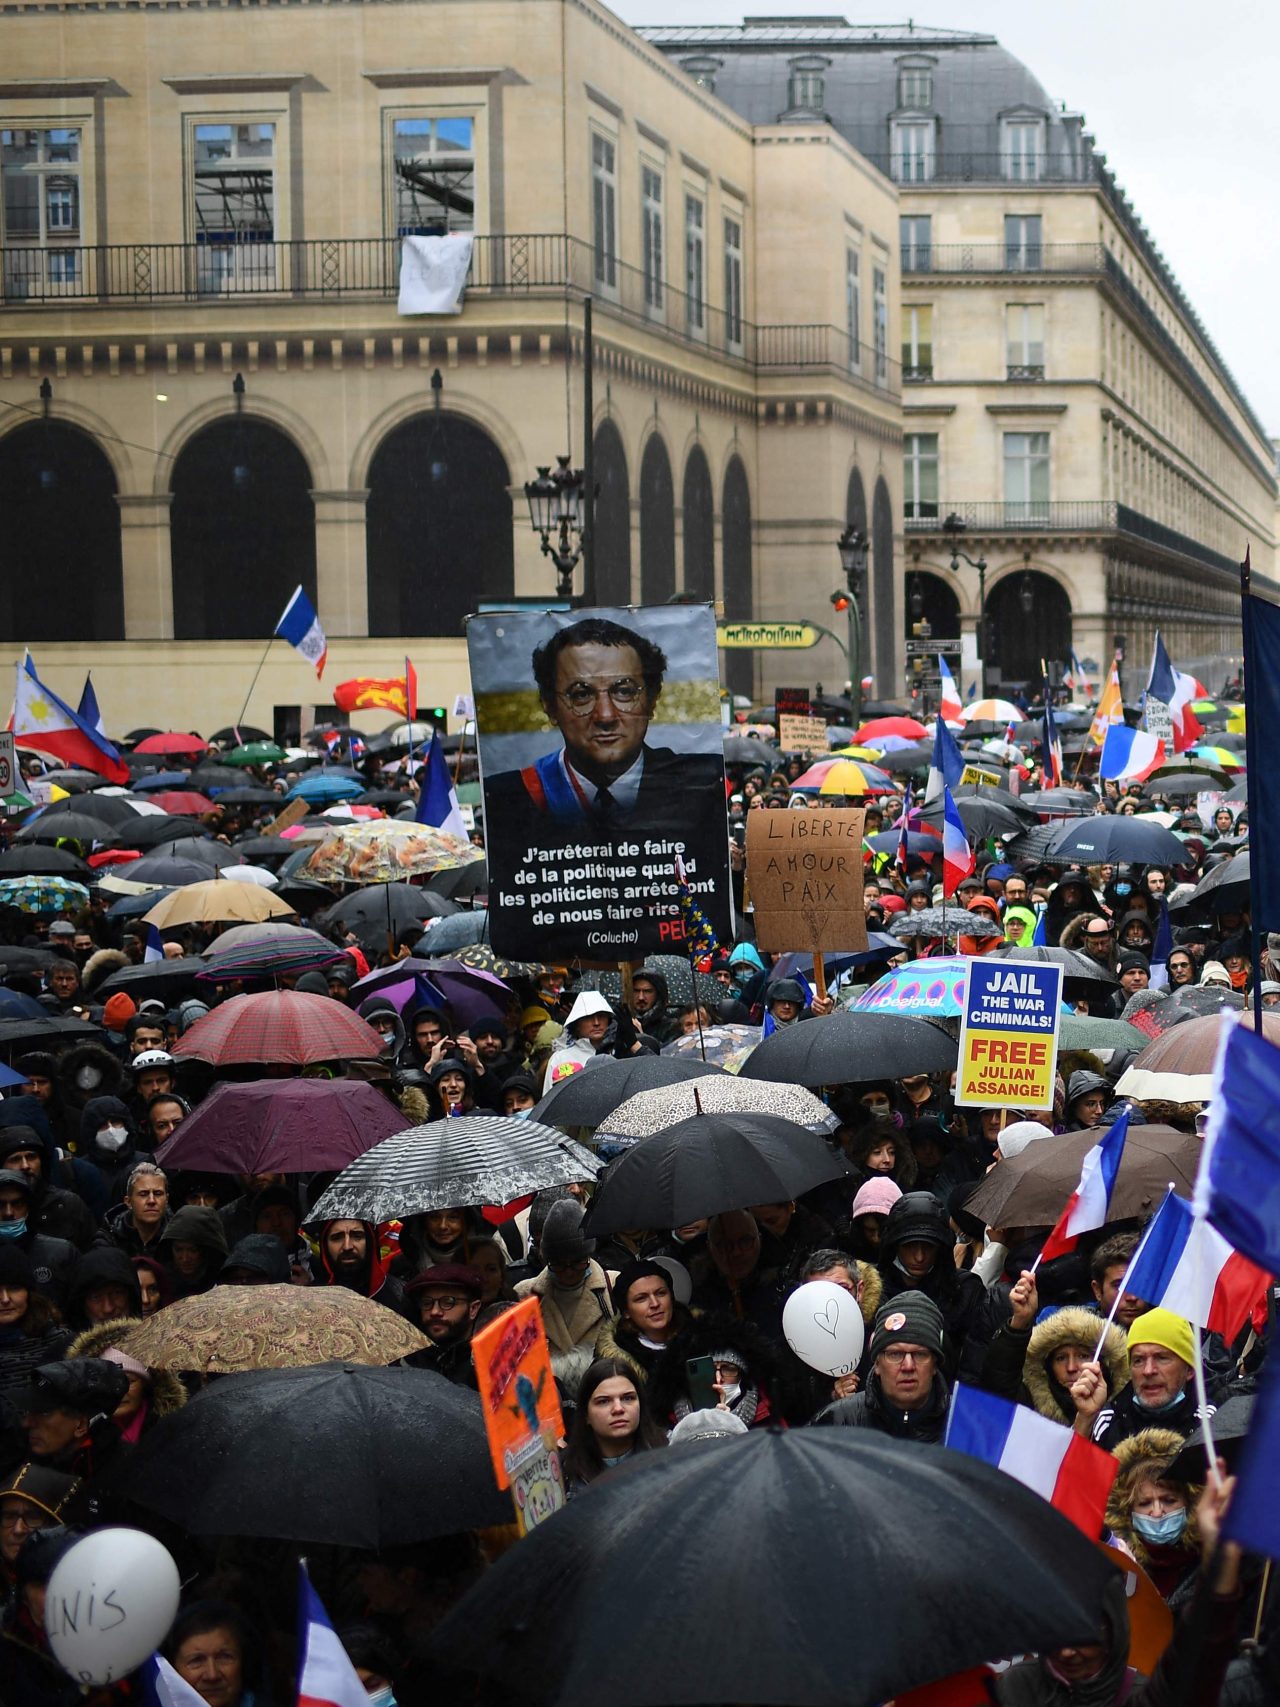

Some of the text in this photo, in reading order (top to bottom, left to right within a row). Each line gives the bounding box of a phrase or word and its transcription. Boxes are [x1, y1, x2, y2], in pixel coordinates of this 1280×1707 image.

[726, 627, 802, 642] METROPOLITAIN
[617, 841, 640, 856] de
[644, 839, 686, 856] faire
[514, 858, 696, 885] de la politique quad
[766, 853, 850, 875] AMOUR
[499, 878, 716, 908] les politiciens arrêteont
[532, 902, 680, 926] de nous faire rire
[587, 929, 639, 947] (Coluche)
[659, 919, 687, 942] PE
[986, 971, 1042, 995] JAIL
[981, 996, 1045, 1011] THE WAR
[970, 1011, 1052, 1027] CRIMINALS!
[970, 1039, 1047, 1066] FREE
[979, 1066, 1035, 1081] JULIAN
[966, 1081, 1045, 1097] ASSANGE!
